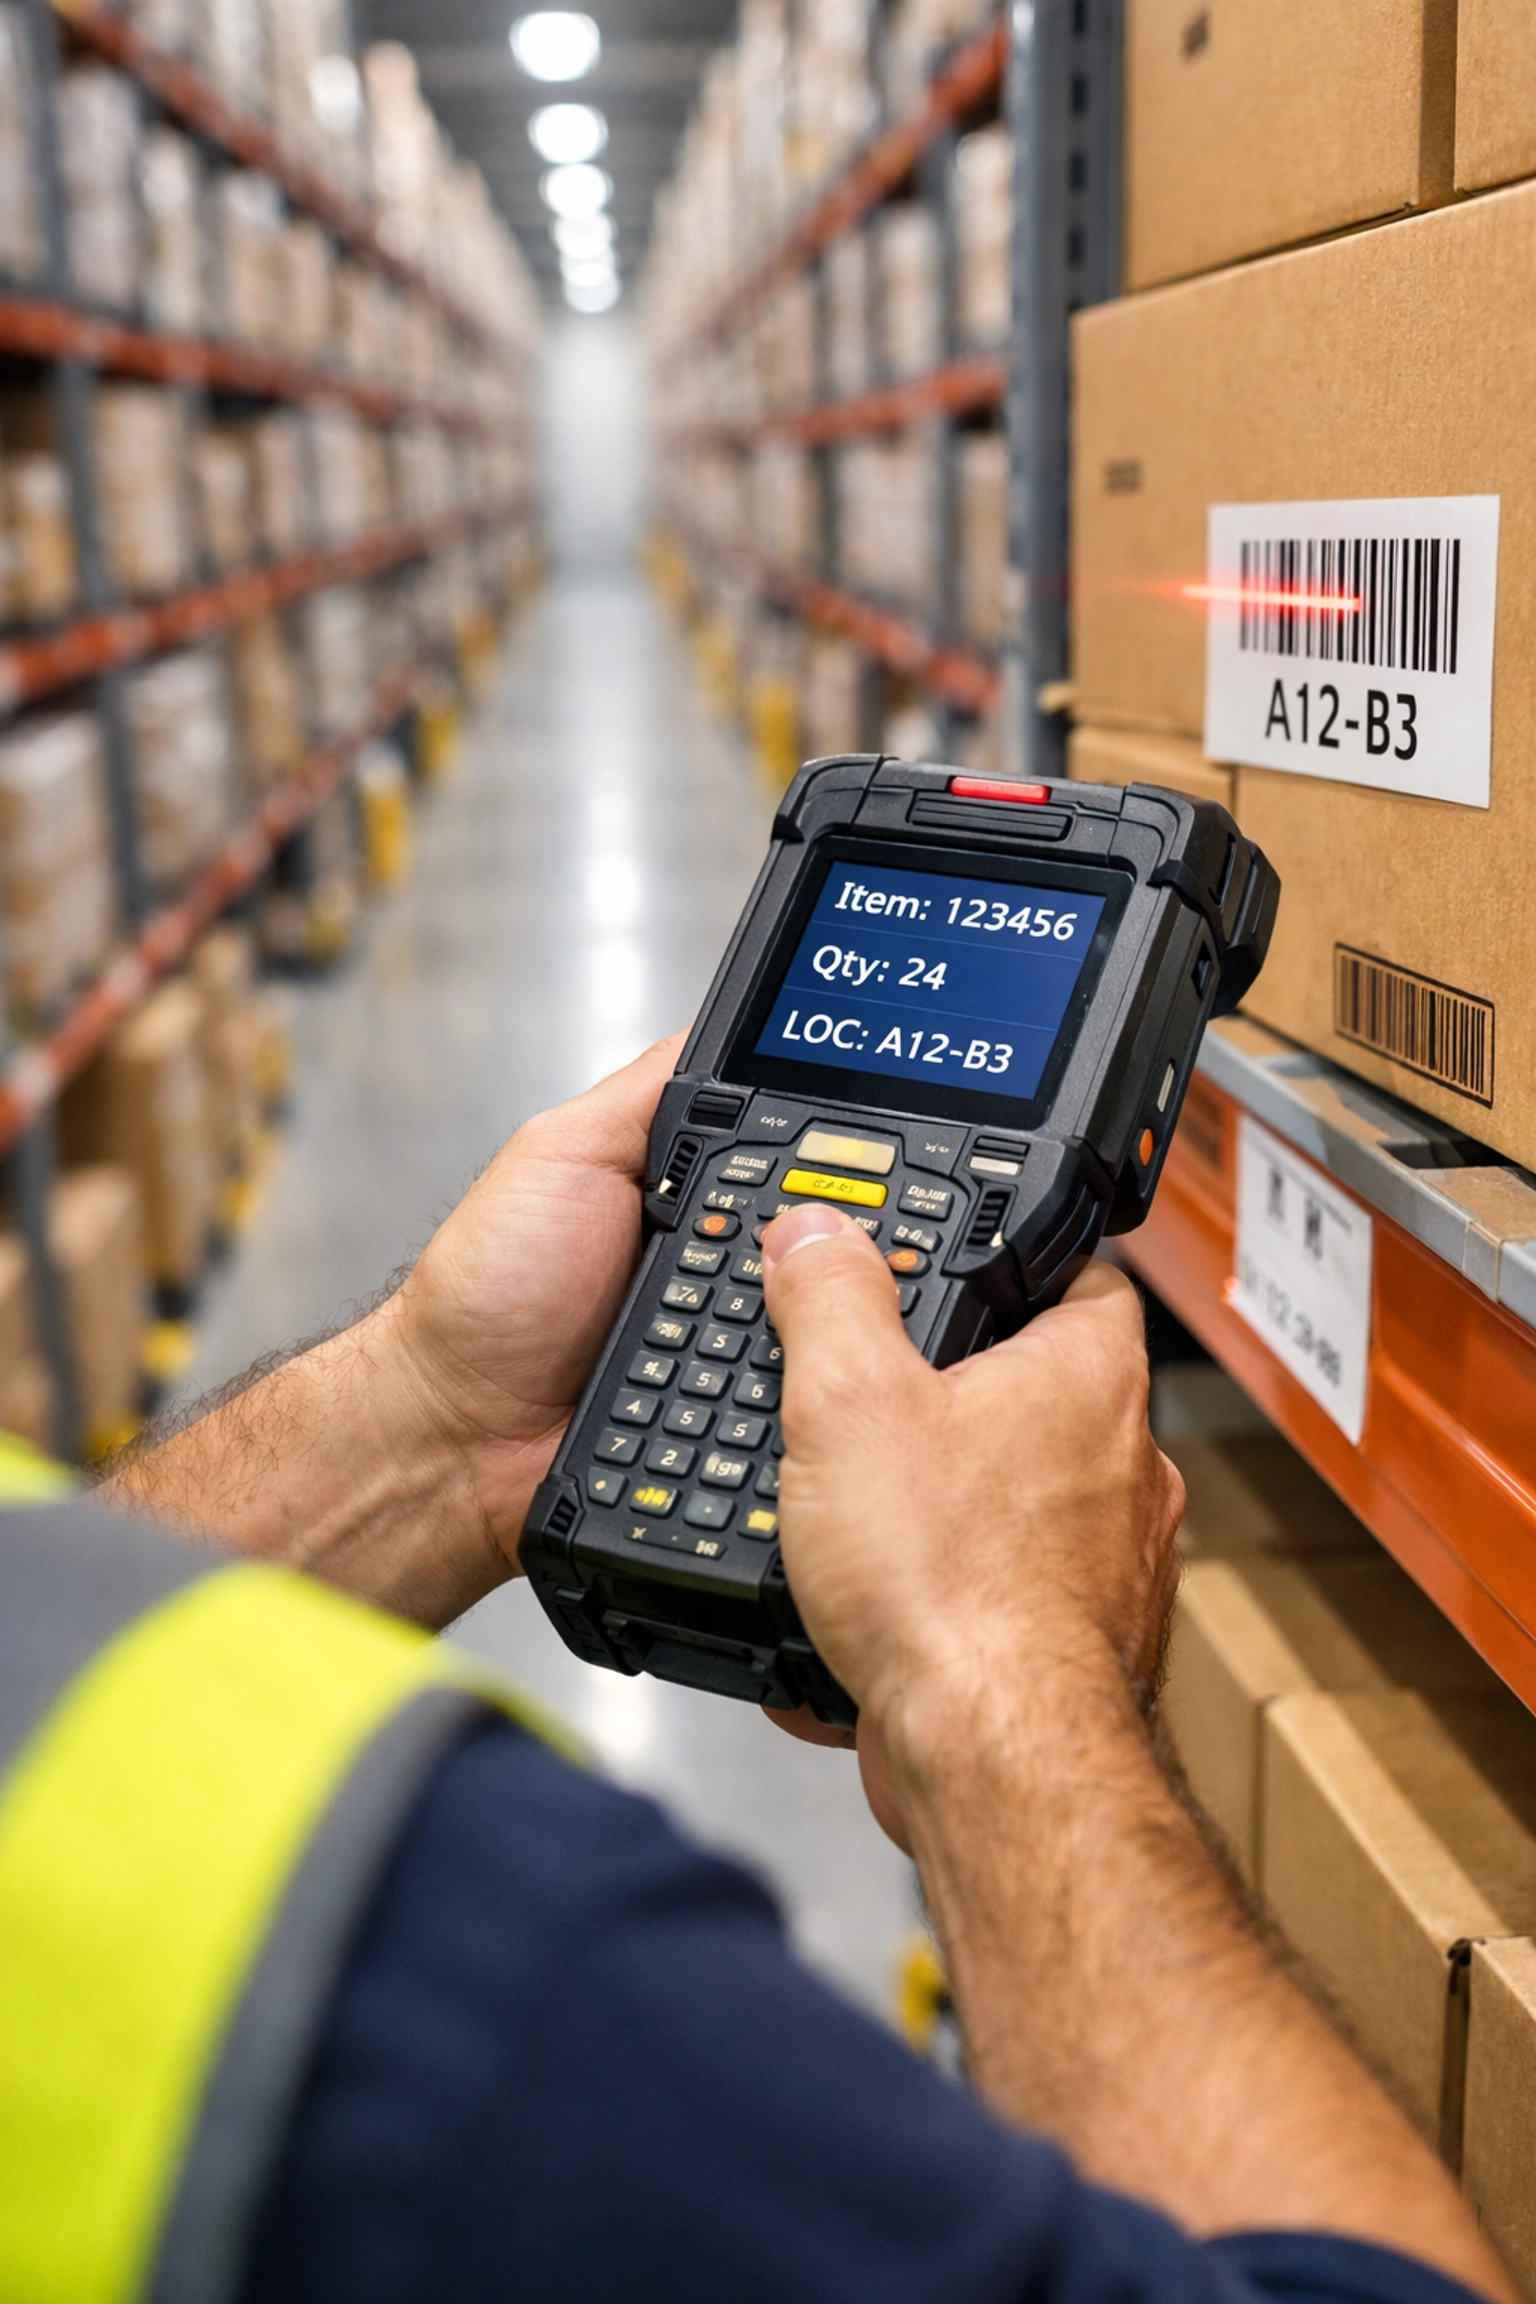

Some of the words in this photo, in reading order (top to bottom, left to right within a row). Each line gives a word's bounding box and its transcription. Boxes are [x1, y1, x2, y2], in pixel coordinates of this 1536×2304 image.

[1265, 678, 1419, 762] A12-B3
[833, 880, 932, 922] Item:
[944, 896, 1079, 942] 123456
[811, 944, 890, 988] Qty:
[898, 956, 948, 991] 24
[781, 1009, 870, 1053] LOC:
[873, 1025, 1014, 1075] A12-B3
